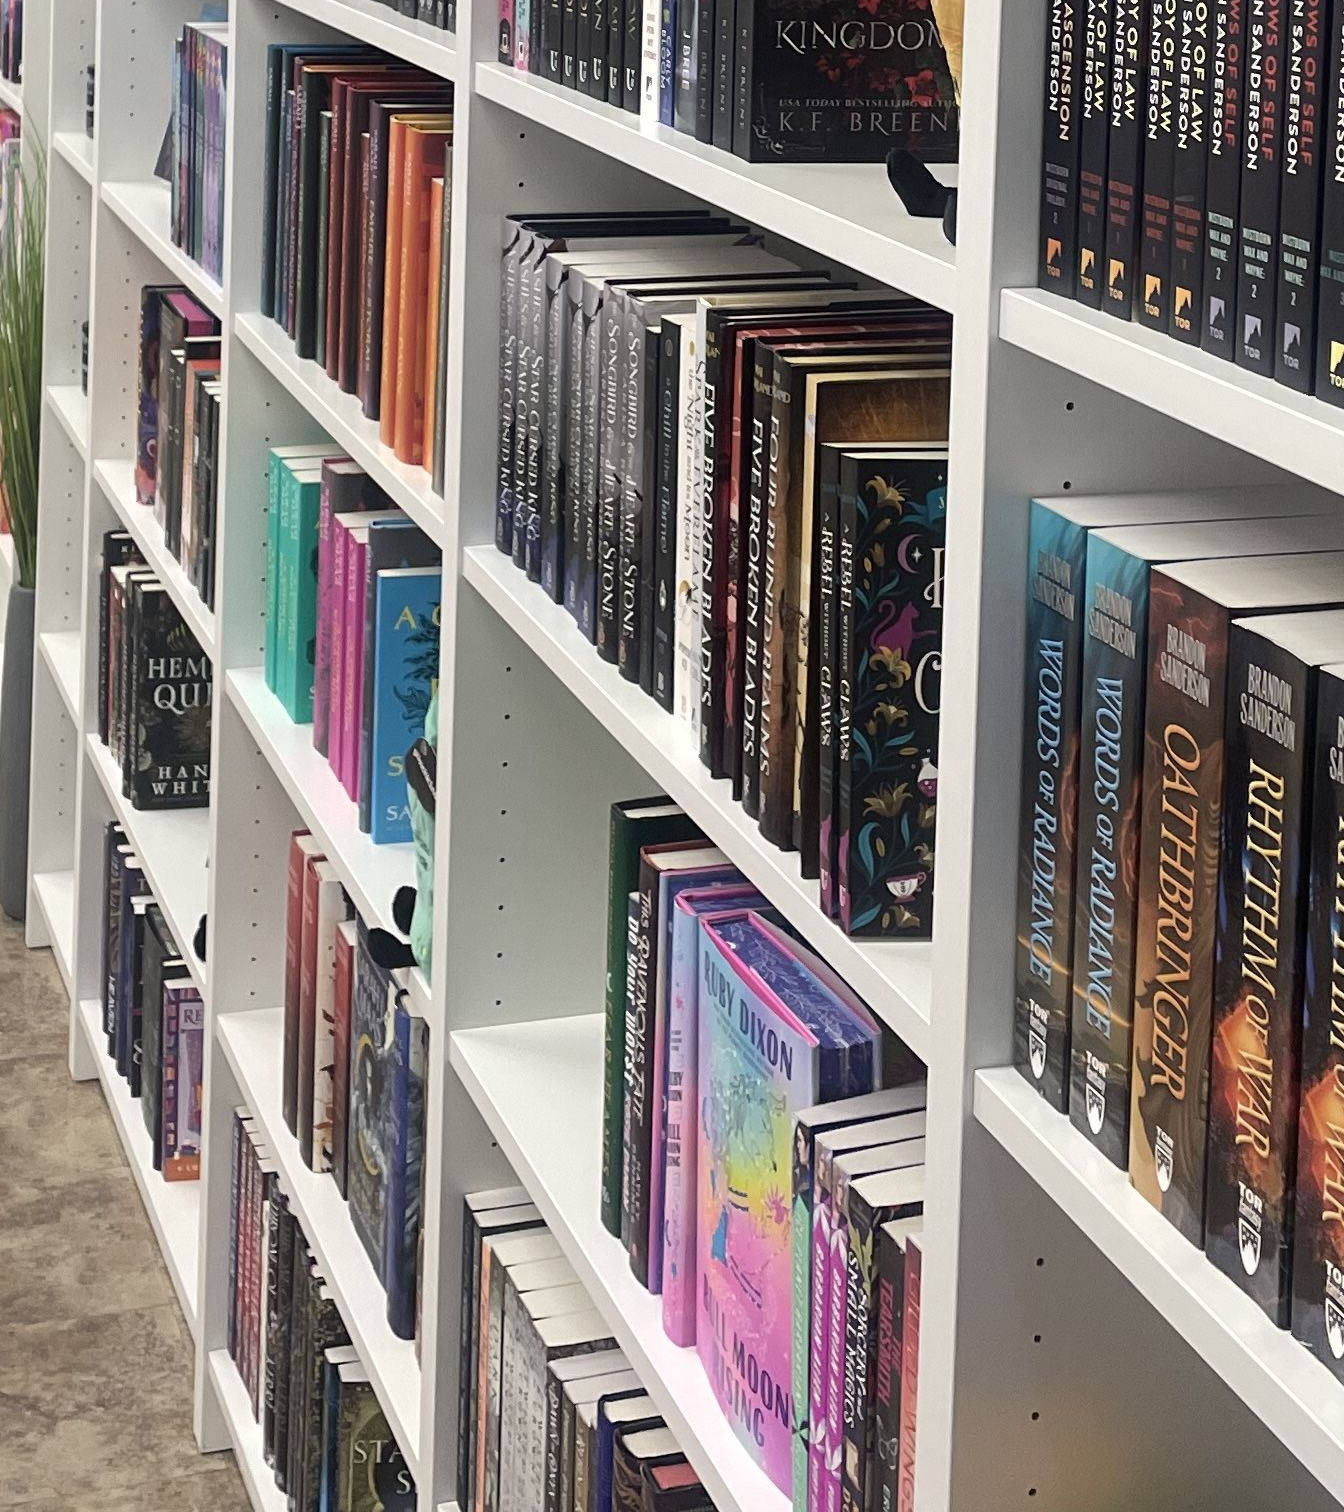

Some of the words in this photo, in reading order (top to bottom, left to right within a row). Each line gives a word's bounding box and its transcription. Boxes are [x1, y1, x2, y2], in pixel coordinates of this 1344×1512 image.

[1059, 4, 1074, 142] ASCENSION
[1192, 46, 1206, 82] OF
[1263, 55, 1278, 93] OF
[851, 112, 950, 136] BREEN
[1188, 88, 1205, 143] LAW
[1261, 100, 1276, 162] SELF
[1174, 314, 1191, 331] TOR
[750, 416, 763, 488] FIVE
[766, 415, 780, 512] FOUR
[745, 495, 761, 628] BROKEN
[764, 518, 777, 643] RUINED
[839, 536, 853, 618] REBEL
[743, 636, 758, 758] BLADES
[759, 645, 774, 778] REALMS
[839, 678, 852, 762] CLAWS
[1093, 676, 1123, 813] WORDS
[1095, 814, 1114, 852] OF
[1150, 723, 1202, 1101] OATHBRINGER
[1241, 757, 1286, 1000] RHYTHM
[1086, 847, 1117, 1039] RADIANCE
[703, 950, 734, 1018] RUBY
[739, 997, 793, 1081] DIXON
[1245, 994, 1272, 1052] OF
[1234, 1048, 1274, 1160] WAR
[1238, 1180, 1264, 1214] TOR
[843, 1250, 859, 1337] SMALL
[732, 1331, 790, 1429] MOON
[841, 1342, 856, 1430] MAGICS
